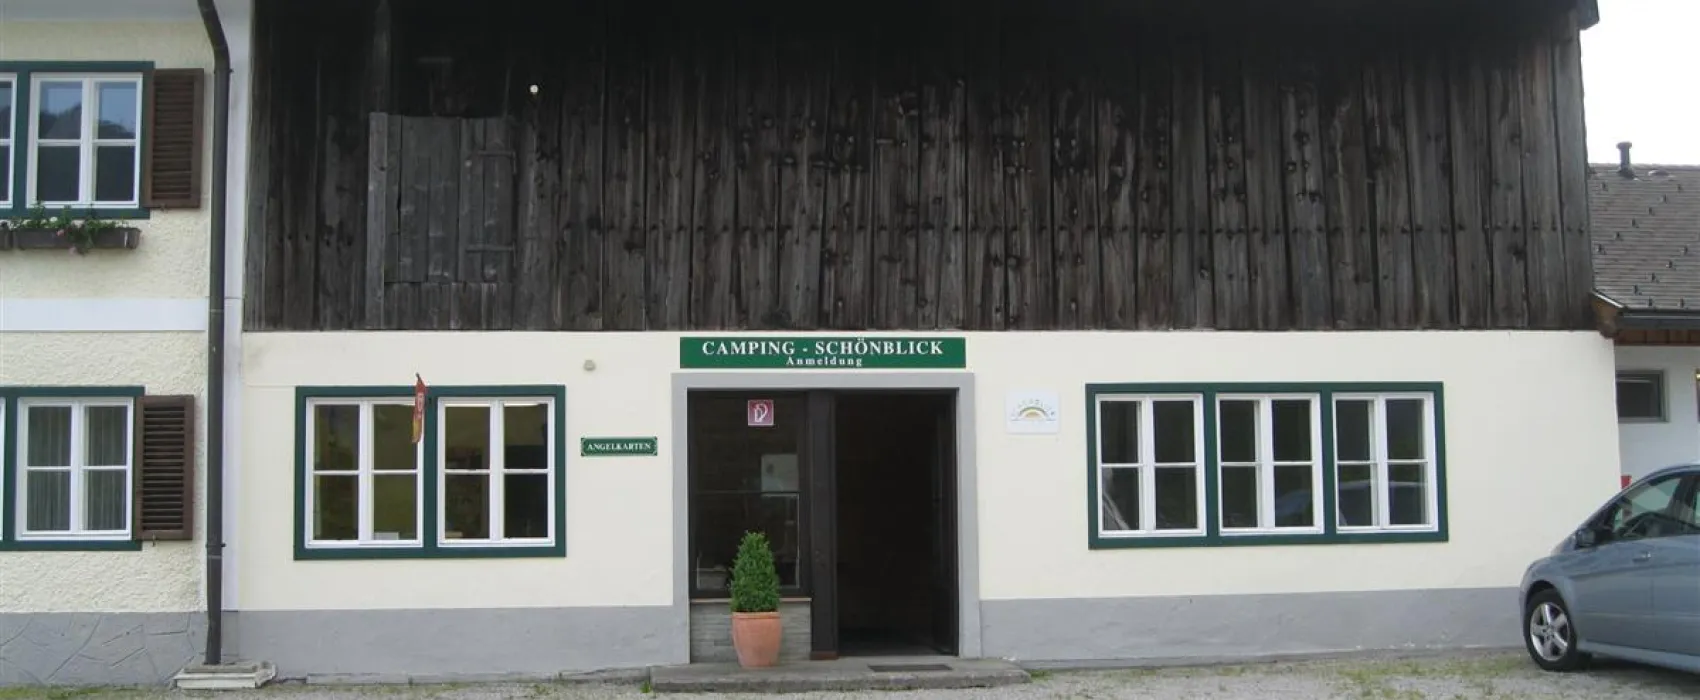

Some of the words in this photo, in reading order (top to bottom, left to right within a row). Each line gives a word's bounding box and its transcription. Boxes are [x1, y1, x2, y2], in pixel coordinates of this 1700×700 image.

[702, 341, 795, 355] CAMPING
[815, 337, 943, 355] SCHÖNBLICK
[786, 356, 862, 367] Anmeldung
